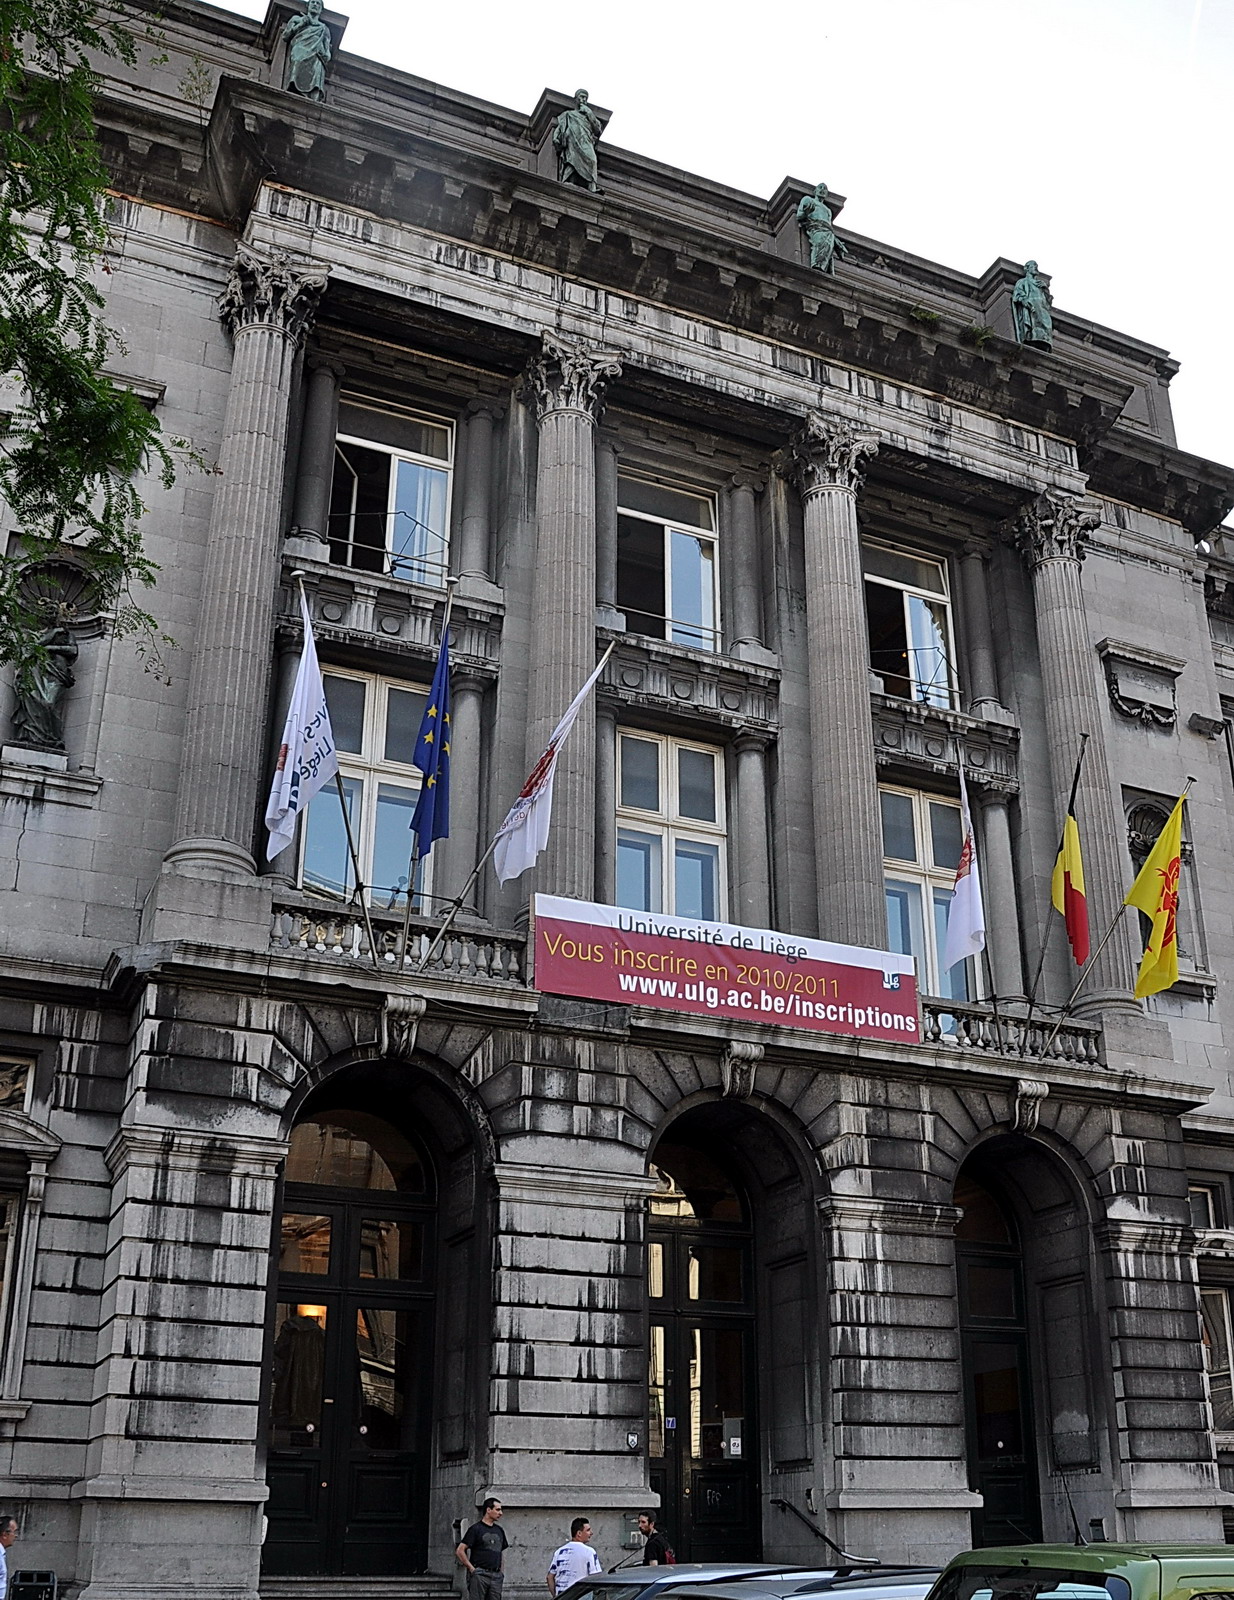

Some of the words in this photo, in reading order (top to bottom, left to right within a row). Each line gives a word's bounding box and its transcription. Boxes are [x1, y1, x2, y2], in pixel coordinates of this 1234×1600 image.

[543, 931, 604, 963] Vous
[614, 941, 698, 977] inscrire
[705, 964, 728, 981] en
[736, 964, 838, 998] 2010/2011
[618, 914, 723, 946] Université
[730, 931, 753, 951] de
[761, 936, 808, 964] Liège
[618, 973, 916, 1032] www.ulg.ac.be/inscriptions
